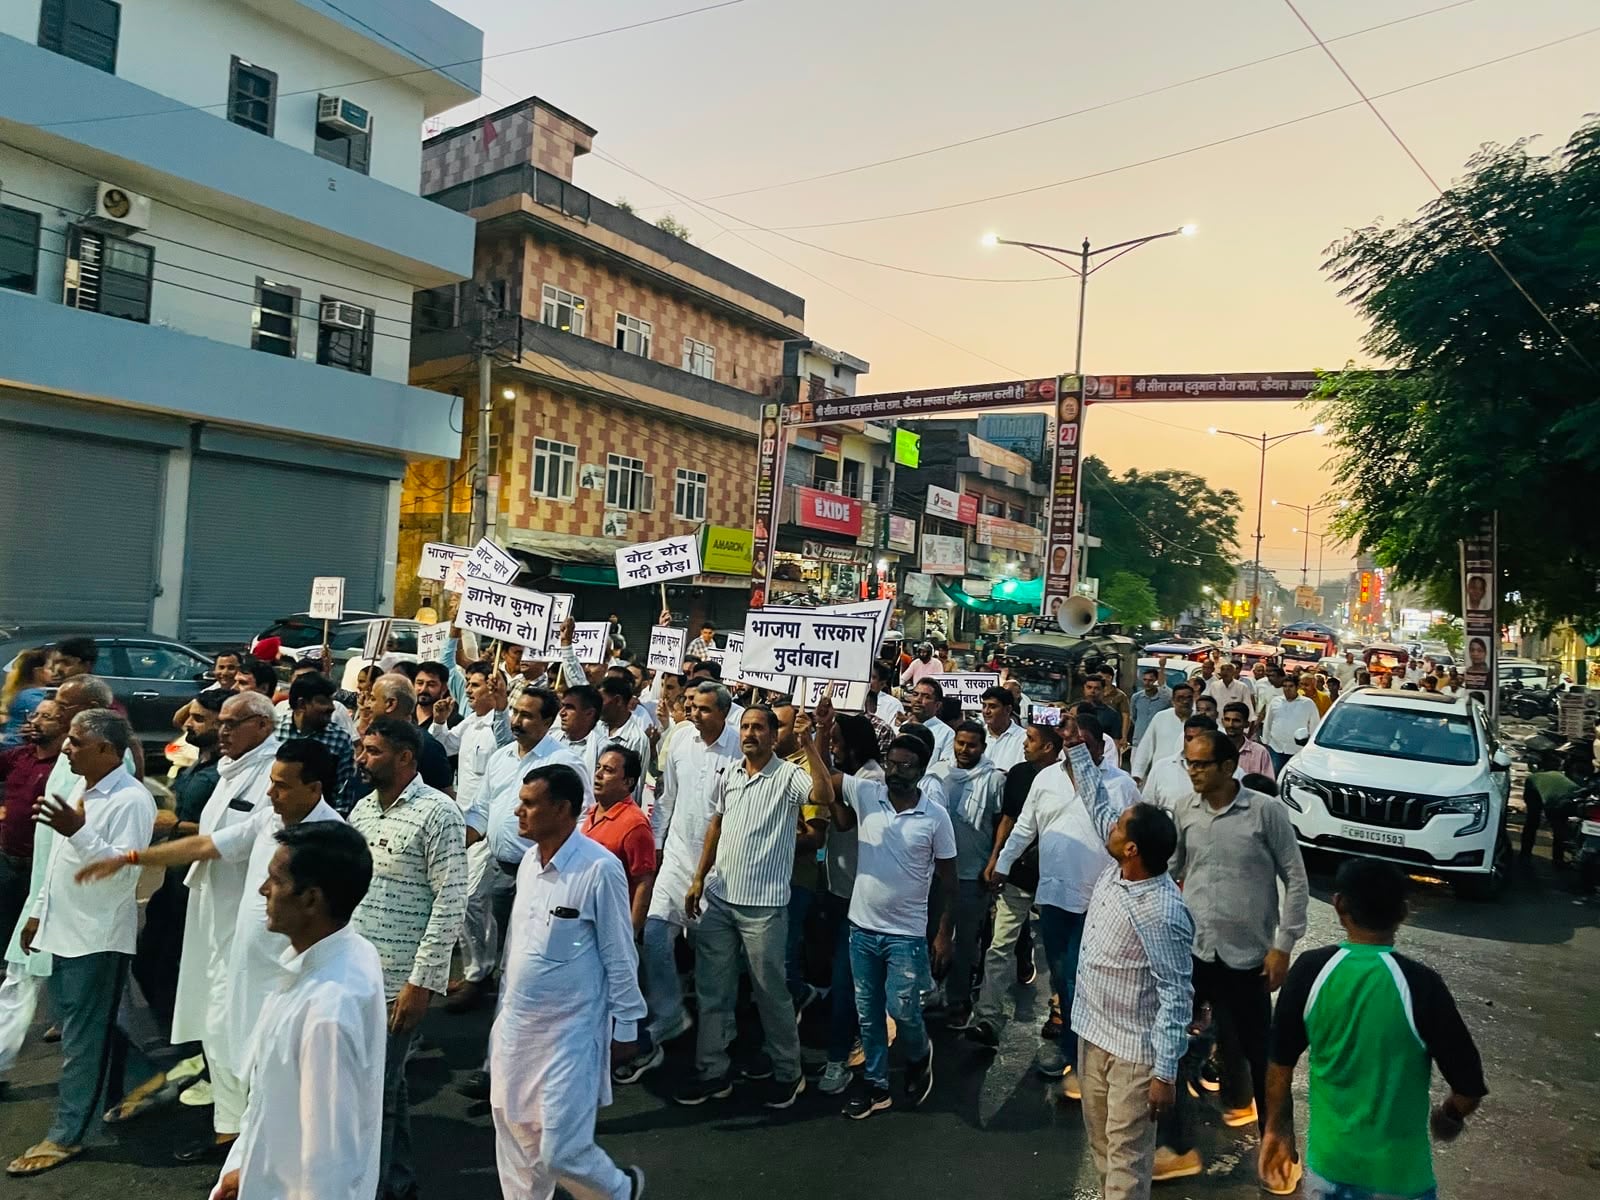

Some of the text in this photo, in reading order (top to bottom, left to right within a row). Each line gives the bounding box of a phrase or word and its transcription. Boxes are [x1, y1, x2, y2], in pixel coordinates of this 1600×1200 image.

[1147, 378, 1167, 392] सीता
[1168, 381, 1183, 392] राम
[1184, 381, 1217, 396] हनुमान
[1218, 376, 1236, 391] सेवा
[1061, 427, 1076, 441] 27
[815, 497, 850, 522] EXIDE
[476, 546, 493, 564] वोट
[493, 560, 509, 578] चोर
[625, 543, 688, 564] वोट चोर
[627, 559, 691, 580] गद्दी छोड़।
[467, 586, 506, 608] ज्ञानेश
[510, 597, 545, 617] कुमार
[464, 610, 512, 635] इस्तीफा
[516, 622, 537, 641] दो।
[751, 620, 868, 643] भाजपा सरकार
[575, 645, 593, 658] दो।
[774, 643, 840, 673] मुर्दाबाद।
[964, 679, 995, 690] सरकार
